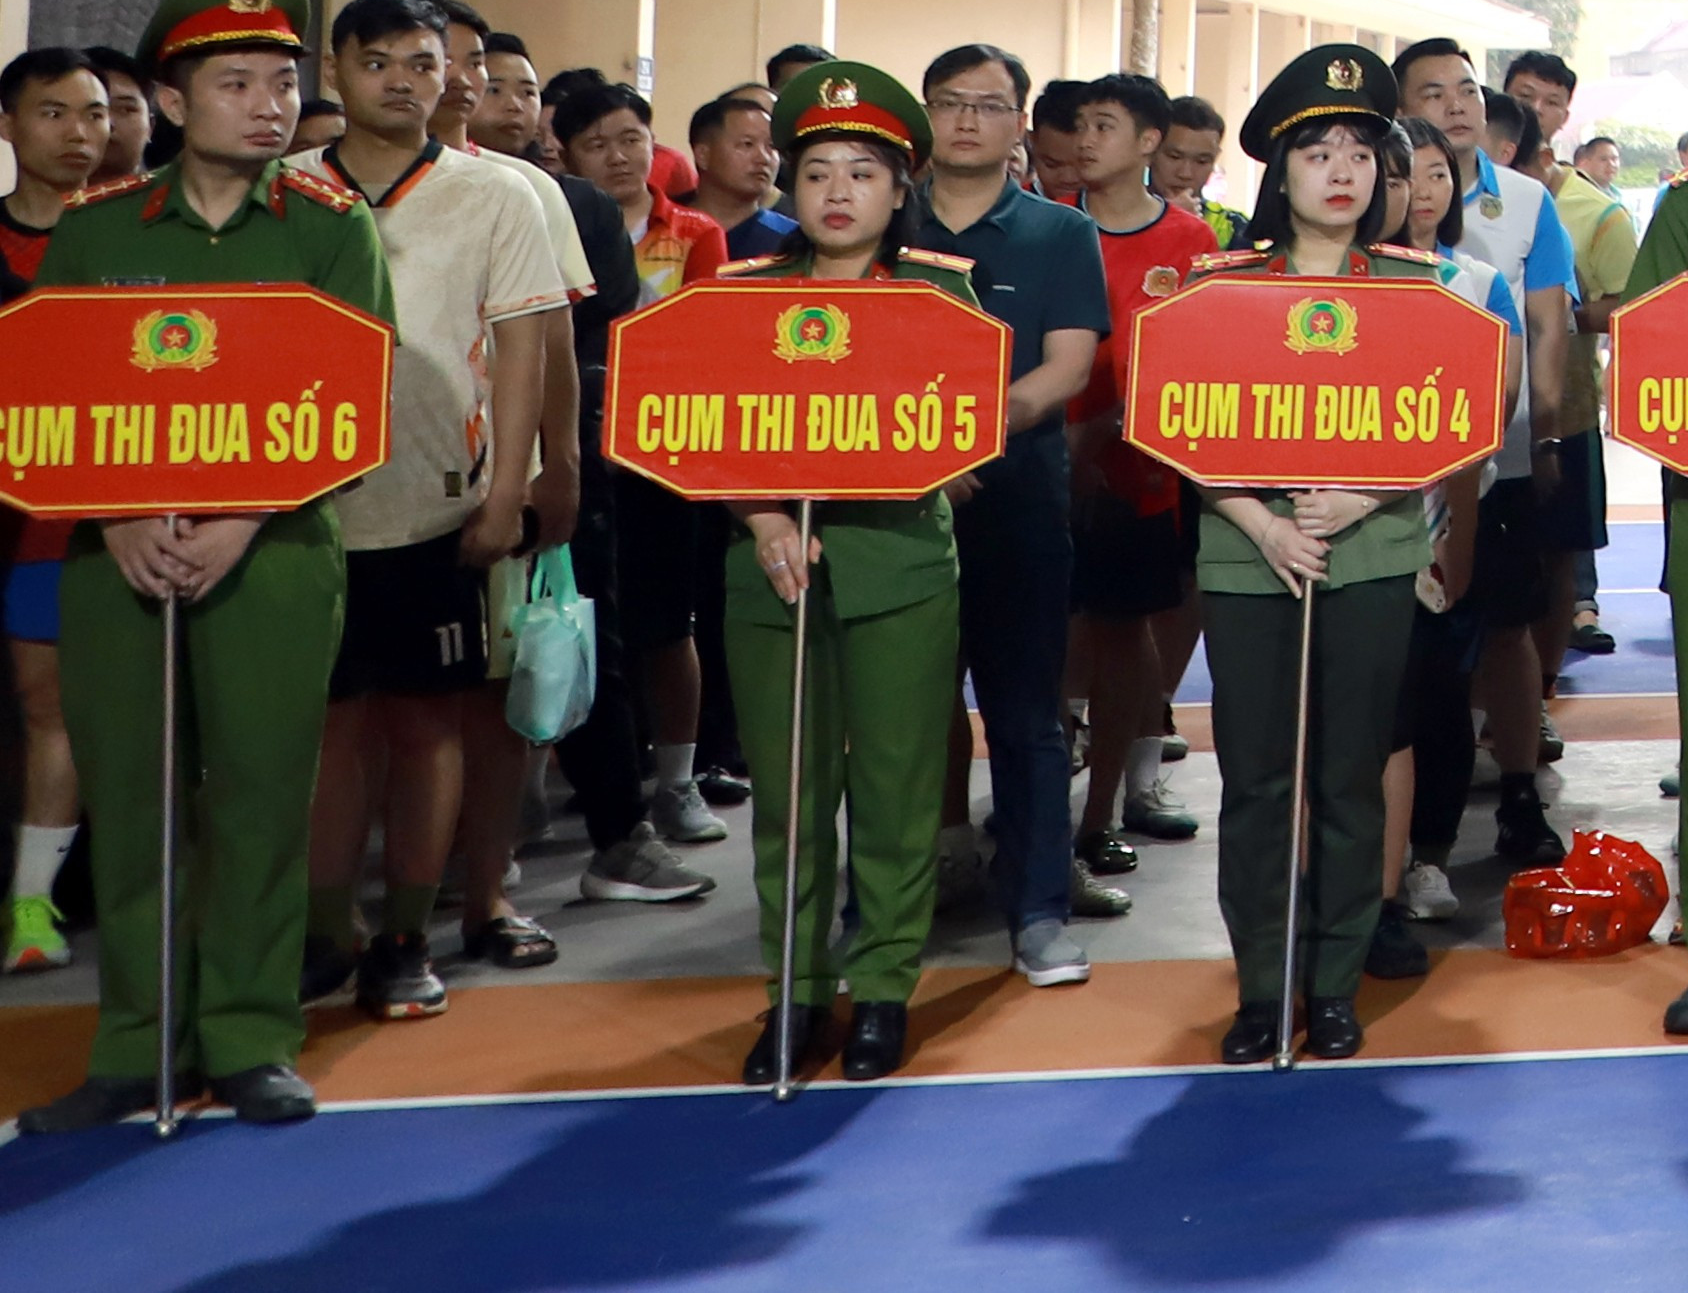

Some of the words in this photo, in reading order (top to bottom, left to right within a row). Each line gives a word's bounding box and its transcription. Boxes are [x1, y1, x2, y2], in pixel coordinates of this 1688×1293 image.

[0, 405, 76, 481] ỤM
[90, 404, 156, 465] THI
[168, 402, 251, 464] ĐUA
[264, 380, 323, 463] SỐ
[332, 402, 357, 462] 6
[636, 393, 726, 466] CỤM
[736, 394, 796, 452] THI
[805, 393, 881, 453] ĐUA
[892, 373, 945, 452] SỐ
[953, 394, 977, 452] 5
[1158, 381, 1241, 452] CỤM
[1251, 383, 1306, 440] THI
[1314, 384, 1383, 442] ĐUA
[1393, 366, 1444, 443] SỐ
[1449, 388, 1471, 443] 4
[434, 622, 464, 667] 11
